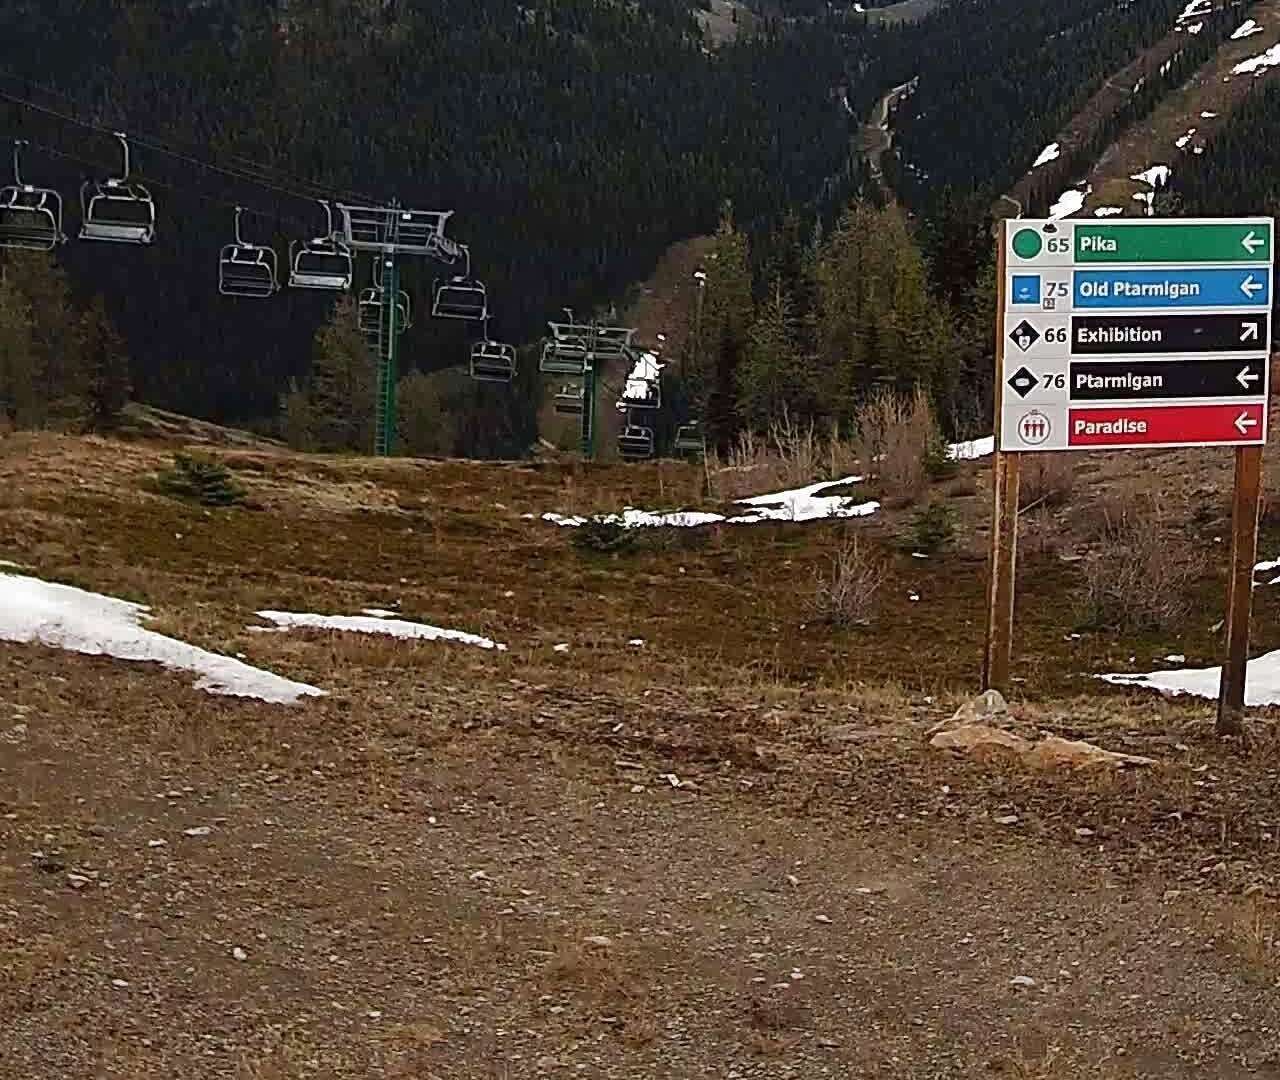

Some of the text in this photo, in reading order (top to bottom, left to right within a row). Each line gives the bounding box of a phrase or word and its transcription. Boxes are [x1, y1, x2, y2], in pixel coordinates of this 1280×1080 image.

[1047, 235, 1117, 253] 65 Pika
[1046, 280, 1200, 299] 75 Old Ptarmigan
[1044, 326, 1162, 343] 66 Exhibition
[1043, 372, 1163, 392] 76 Ptarmigan
[1074, 418, 1147, 435] Paradise
